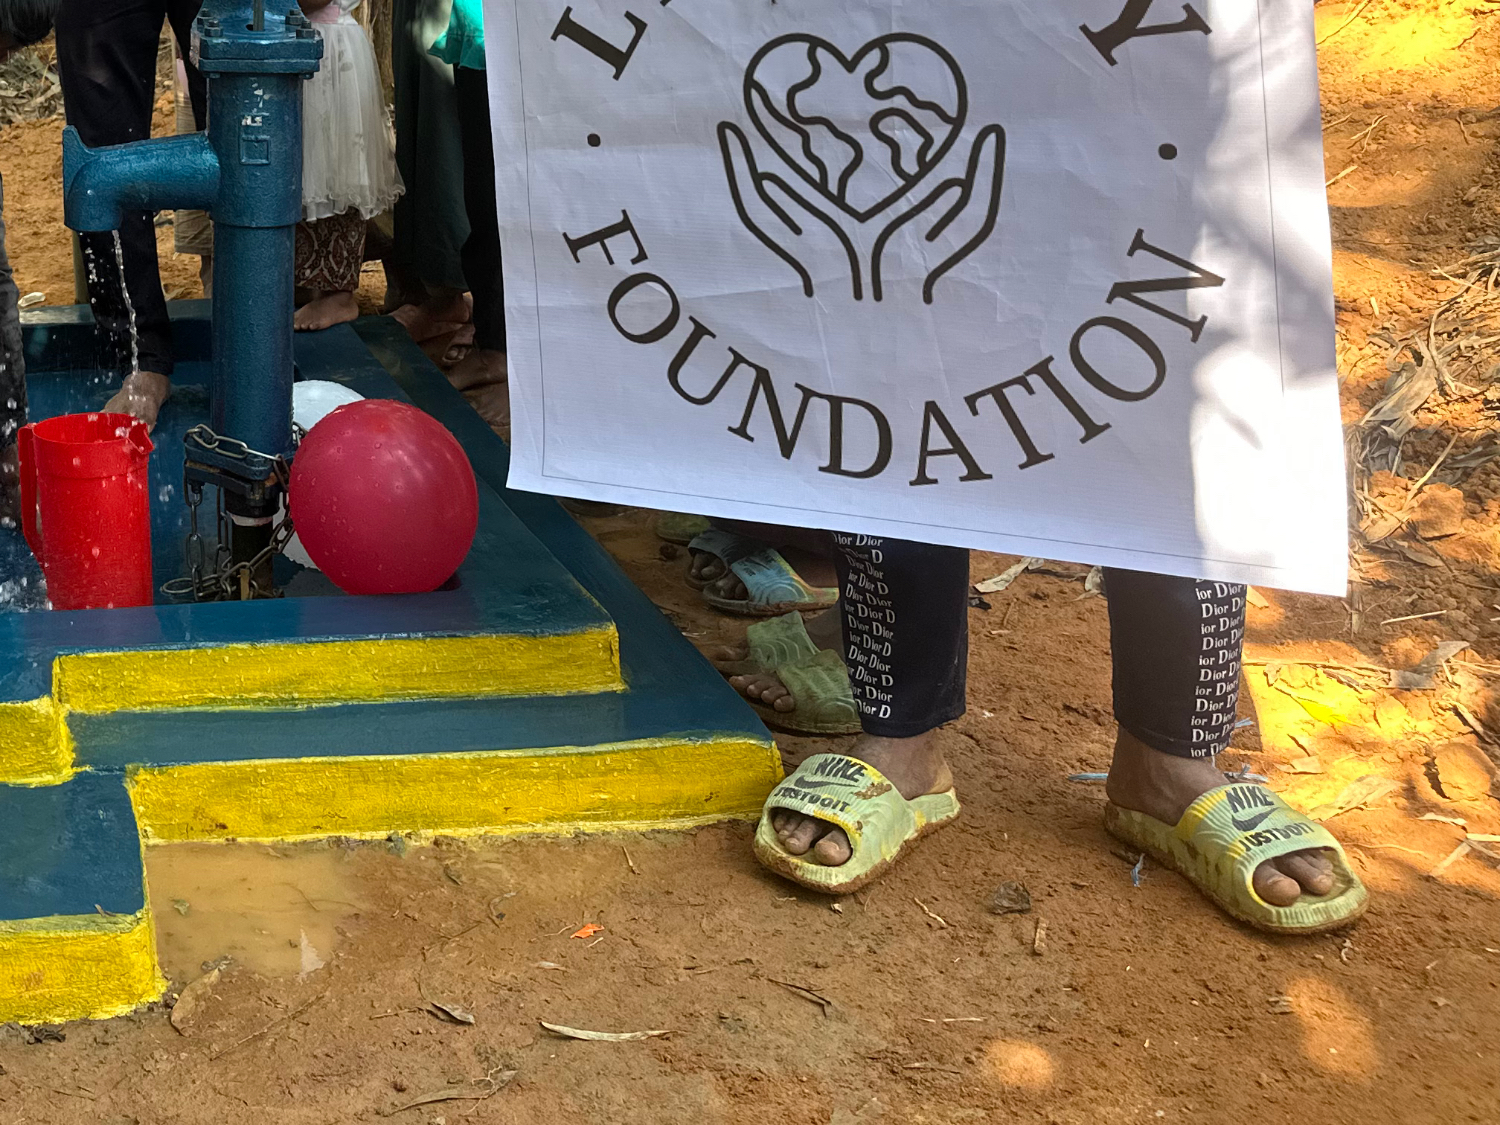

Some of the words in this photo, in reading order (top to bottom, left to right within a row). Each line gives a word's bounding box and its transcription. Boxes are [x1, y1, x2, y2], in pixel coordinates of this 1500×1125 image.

[562, 209, 1227, 487] FOUNDATION
[856, 534, 883, 546] Dior
[865, 561, 884, 579] Dior
[858, 573, 875, 591] Dior
[1213, 582, 1242, 598] Dior
[845, 583, 863, 602] Dior
[866, 592, 892, 607] Dior
[857, 603, 883, 620] Dior
[1201, 603, 1229, 618] Dior
[848, 614, 870, 632] Dior
[872, 621, 894, 639] Dior
[1219, 616, 1240, 632] Dior
[863, 634, 882, 652] Dior
[1202, 637, 1228, 651] Dior
[848, 645, 868, 664] Dior
[868, 654, 891, 672] Dior
[1218, 648, 1239, 665] Dior
[855, 665, 878, 684] Dior
[1199, 668, 1227, 682] Dior
[865, 685, 893, 702] Dior
[1215, 680, 1236, 696] Dior
[1195, 698, 1224, 712] Dior
[1210, 711, 1234, 726] Dior
[1192, 728, 1220, 743] Dior
[814, 757, 868, 782] NIKE
[1225, 786, 1274, 813] NIKE
